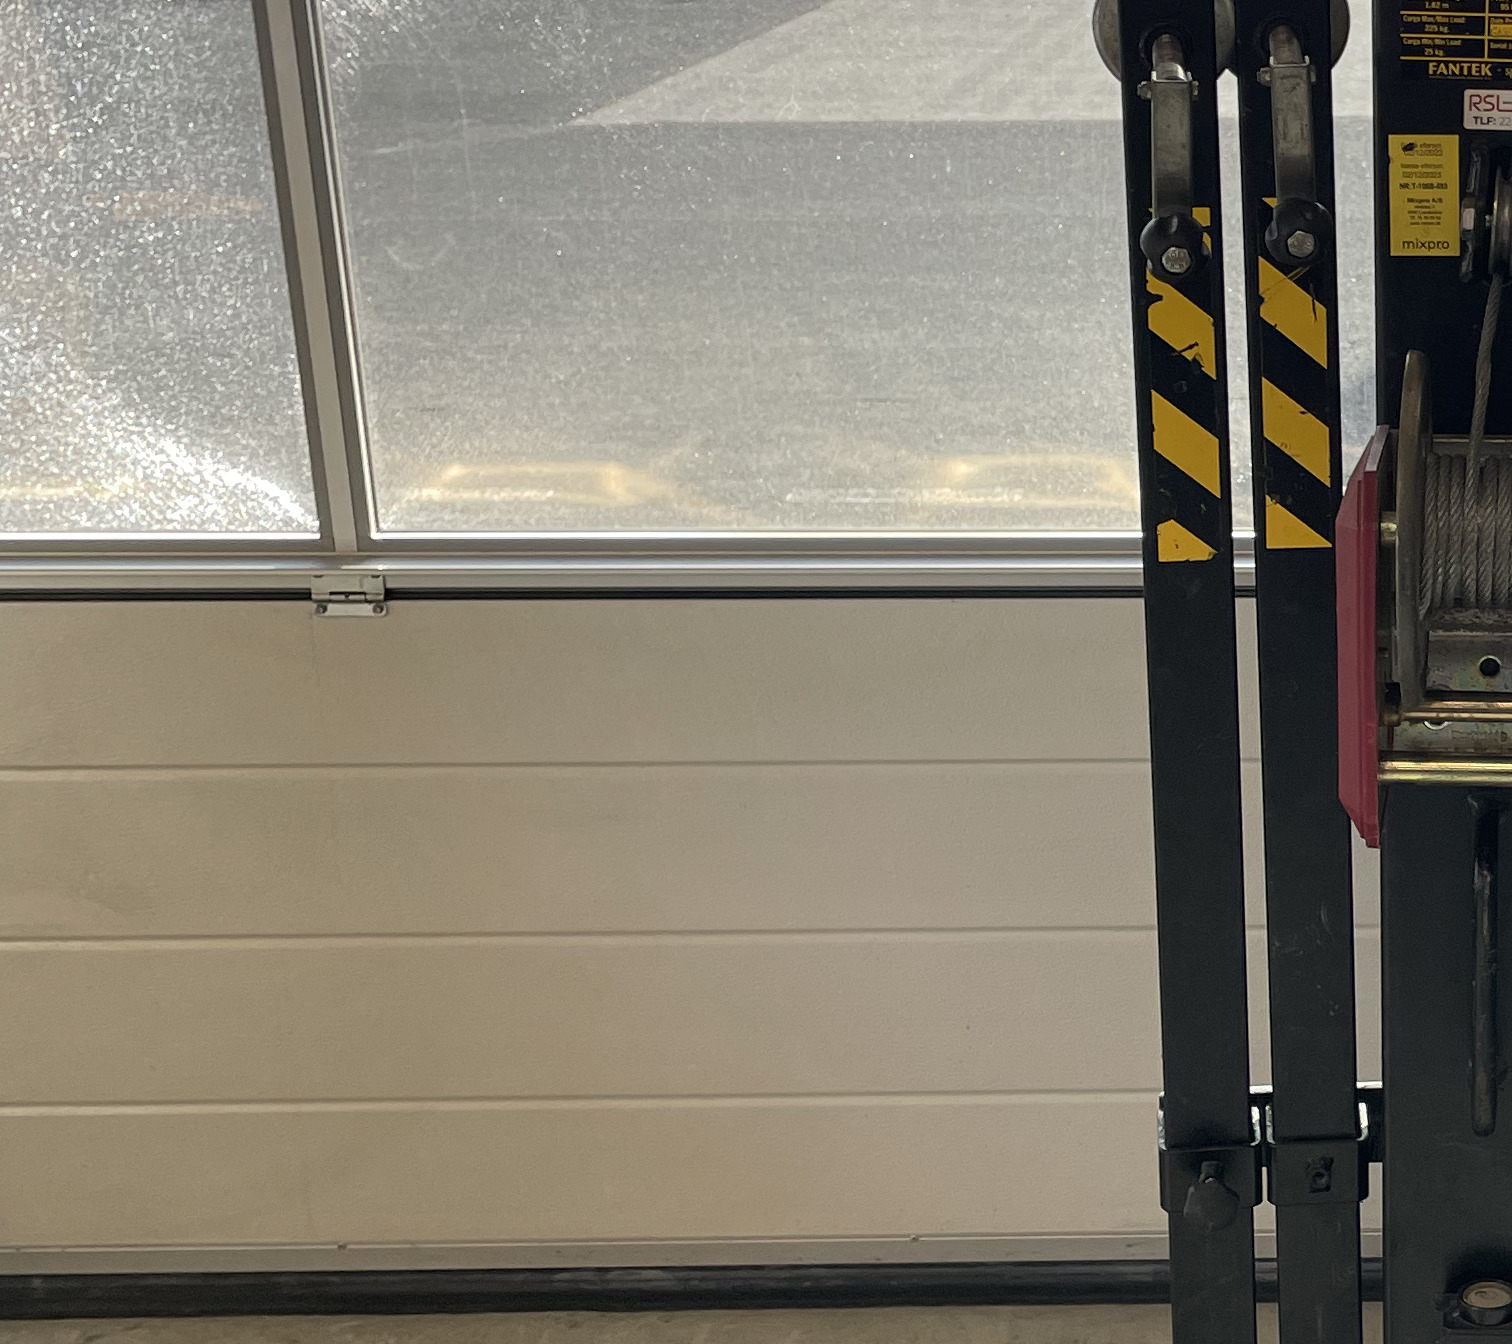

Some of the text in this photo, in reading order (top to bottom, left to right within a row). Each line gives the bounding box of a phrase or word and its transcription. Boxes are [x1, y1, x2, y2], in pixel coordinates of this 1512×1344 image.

[1429, 62, 1492, 77] FANTEK
[1499, 116, 1512, 127] 22
[1402, 237, 1450, 252] mixpro
